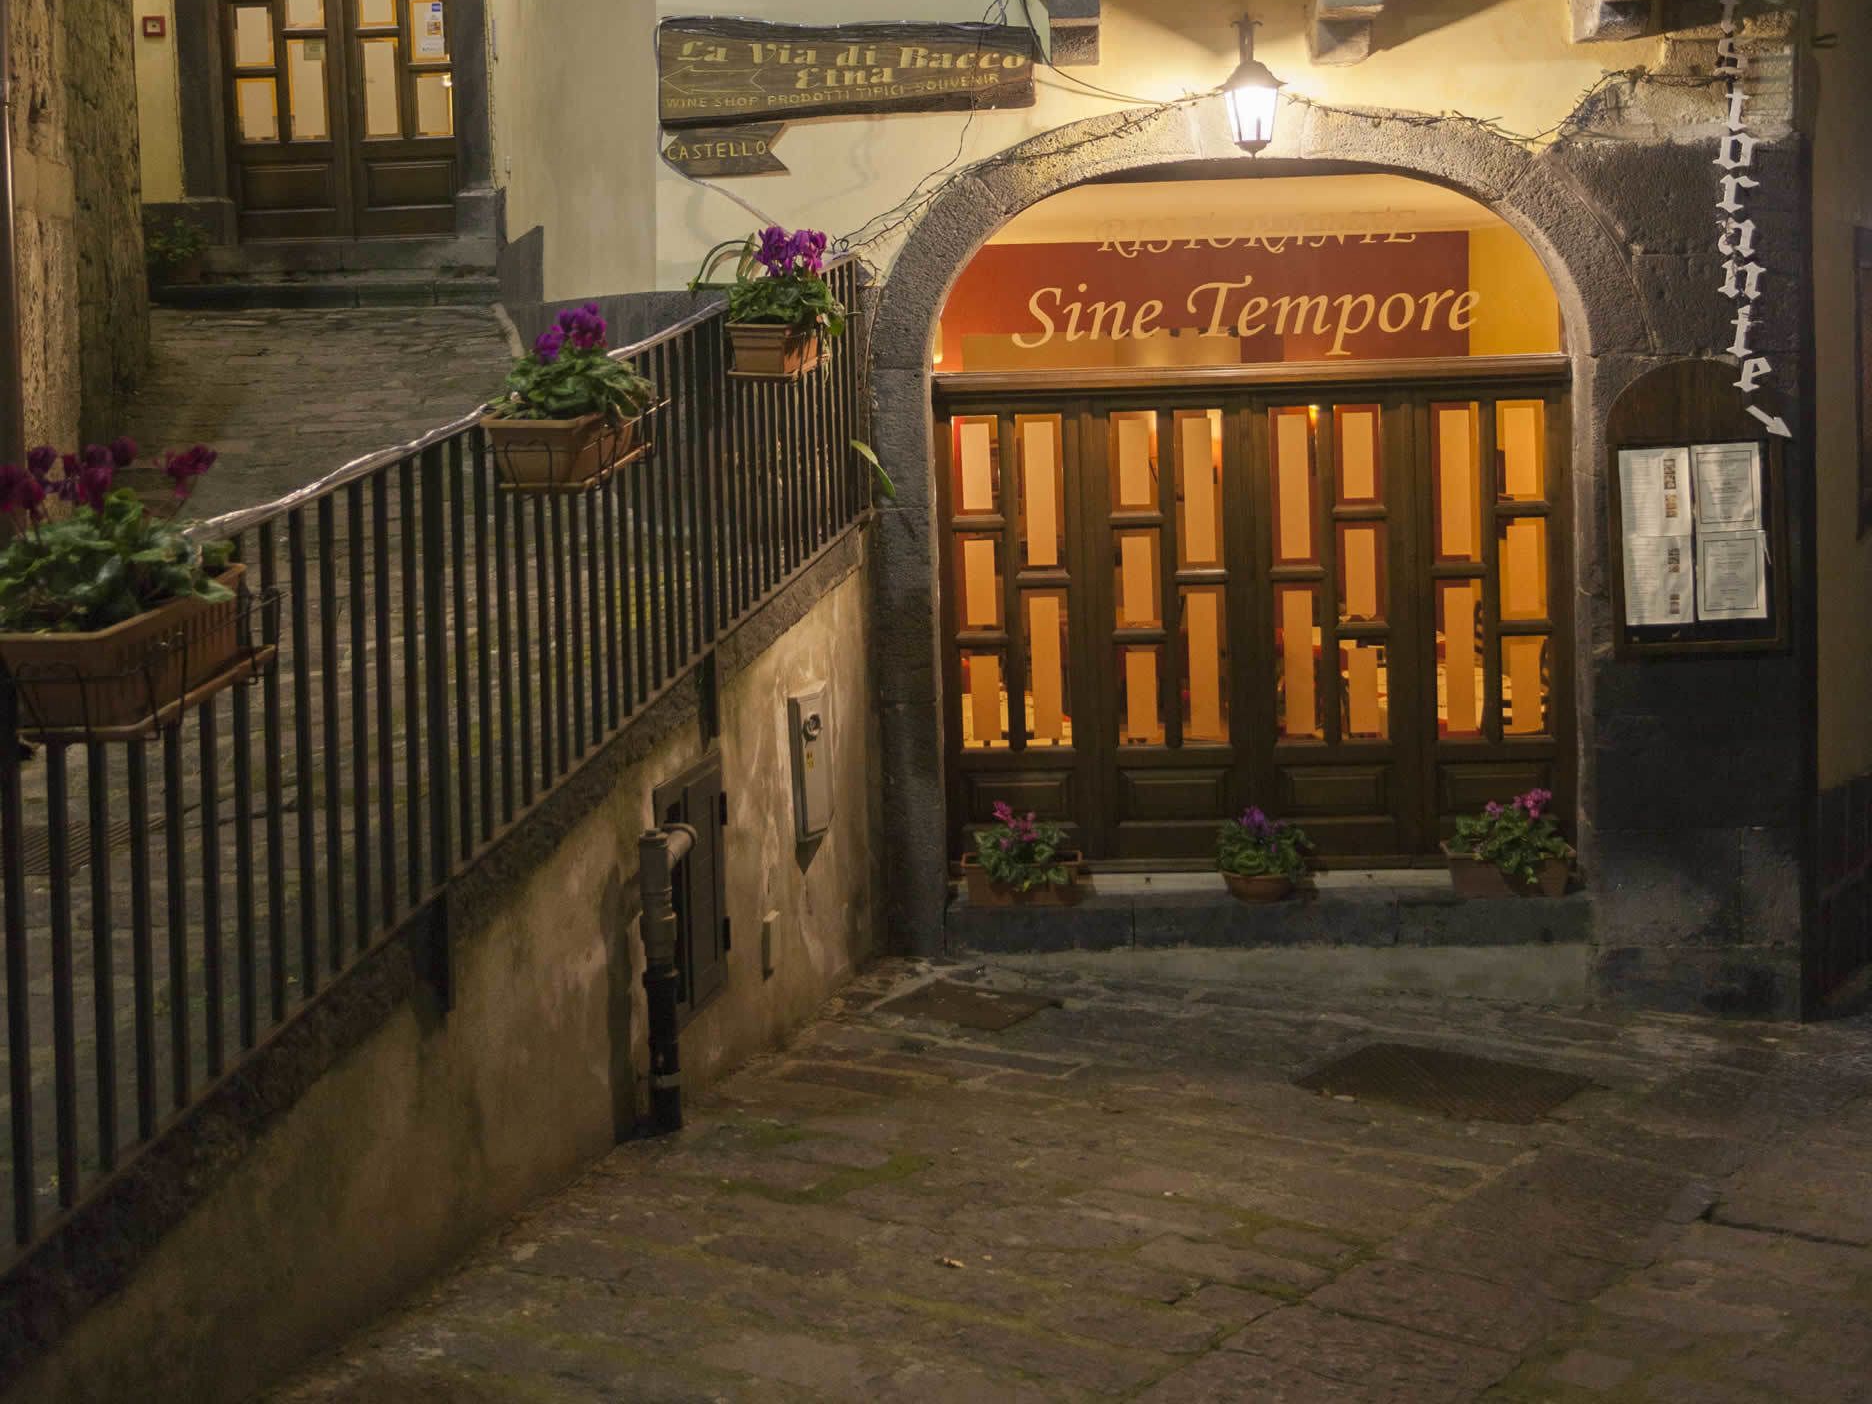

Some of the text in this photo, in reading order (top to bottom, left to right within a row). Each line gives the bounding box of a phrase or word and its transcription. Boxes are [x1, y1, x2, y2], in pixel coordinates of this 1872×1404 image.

[677, 41, 1026, 69] La Via di Bacco
[664, 74, 1001, 109] WINE SHOP PRODOTTI TIPICI SOUVENIR
[795, 67, 895, 89] Etna
[666, 141, 768, 161] CASTELLO
[1011, 275, 1481, 356] Sine Tempore
